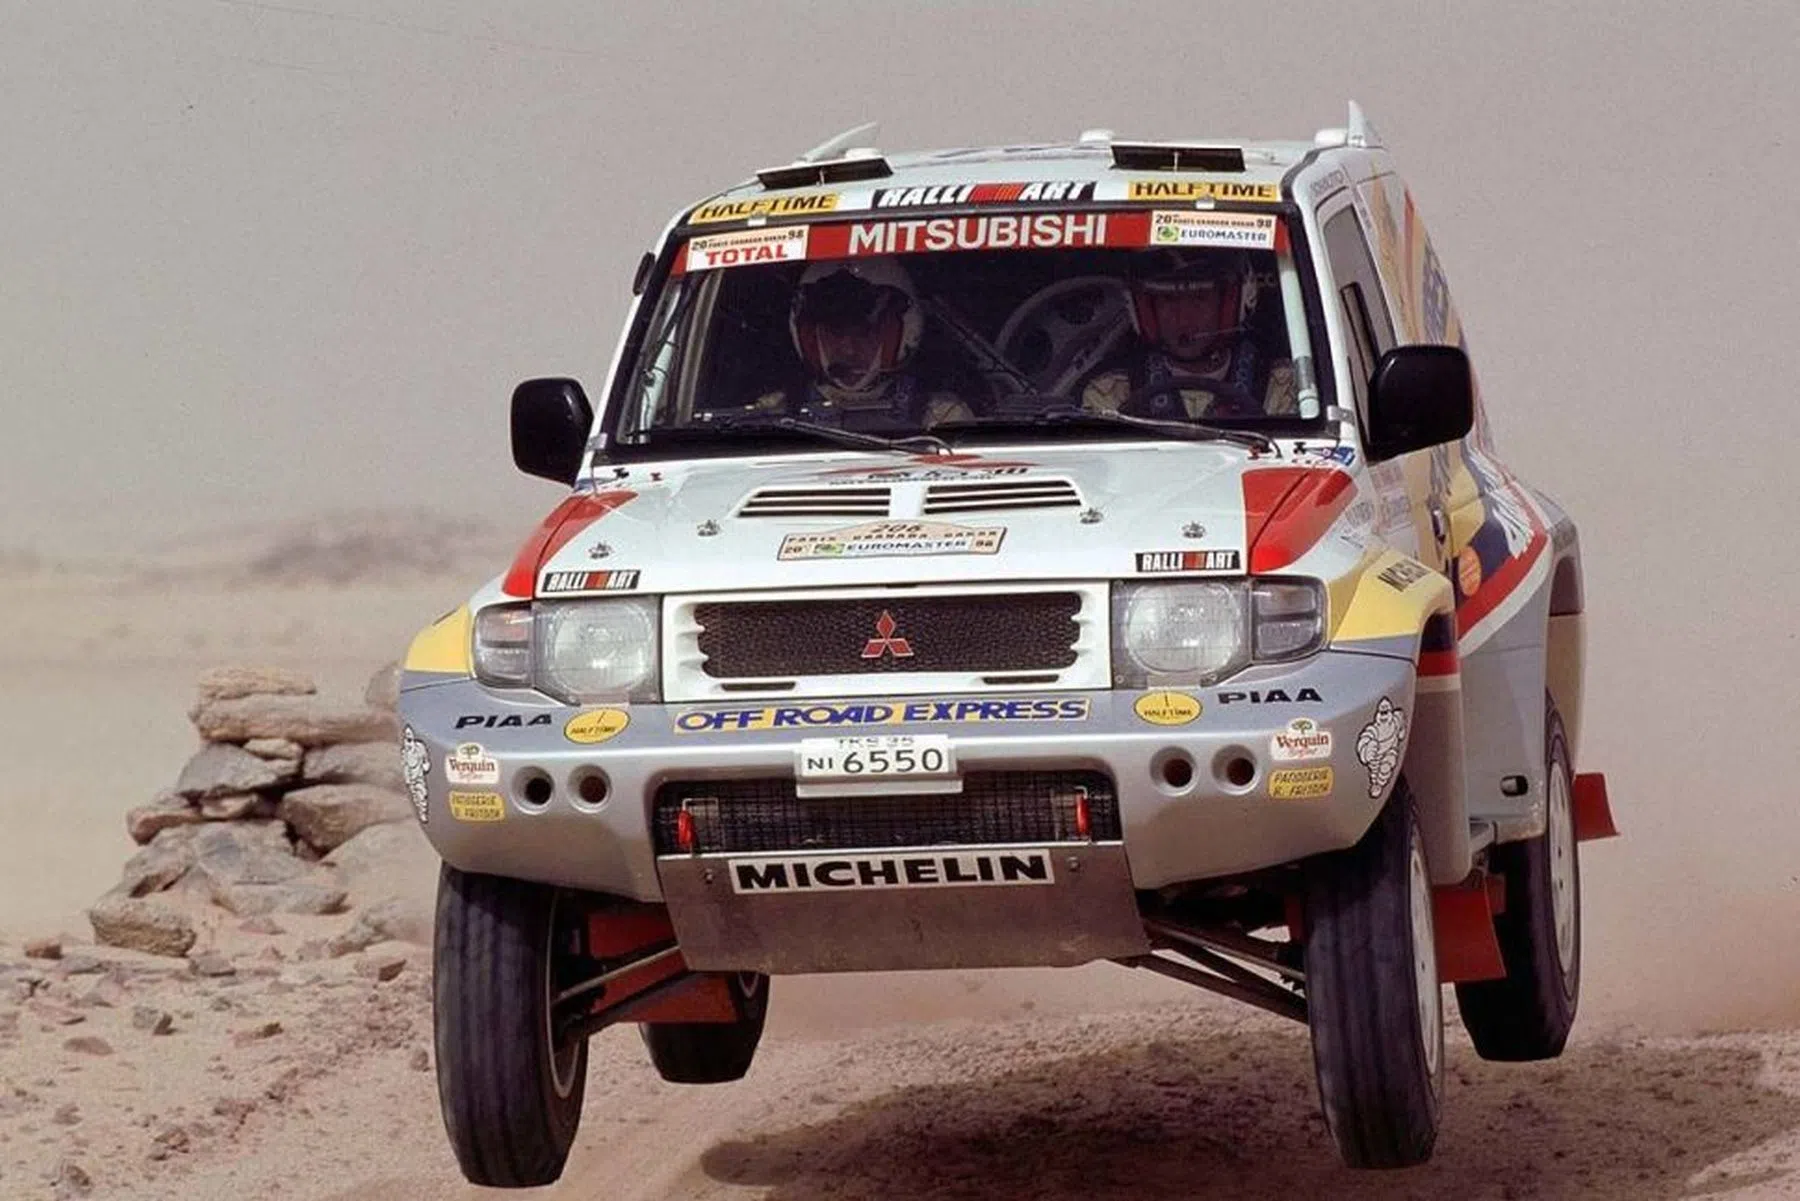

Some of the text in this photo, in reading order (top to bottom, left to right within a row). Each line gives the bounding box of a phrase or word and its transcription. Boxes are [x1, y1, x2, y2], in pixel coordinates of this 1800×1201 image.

[876, 182, 1091, 207] RALLI ART
[848, 214, 1109, 255] MITSUBISHI
[1181, 229, 1269, 242] EUROMASTER
[705, 244, 789, 266] TOTAL
[846, 540, 968, 551] EUROMASTER
[1141, 552, 1235, 571] RALLI ART
[547, 571, 638, 590] RALLI ART
[1217, 688, 1324, 704] PIAA
[454, 713, 552, 729] PIAA
[676, 699, 1086, 731] OFF ROAD EXPRESS
[1275, 733, 1329, 749] Verquin
[448, 757, 496, 773] Verquin
[842, 748, 943, 774] 6550
[735, 854, 1048, 890] MICHELIN
